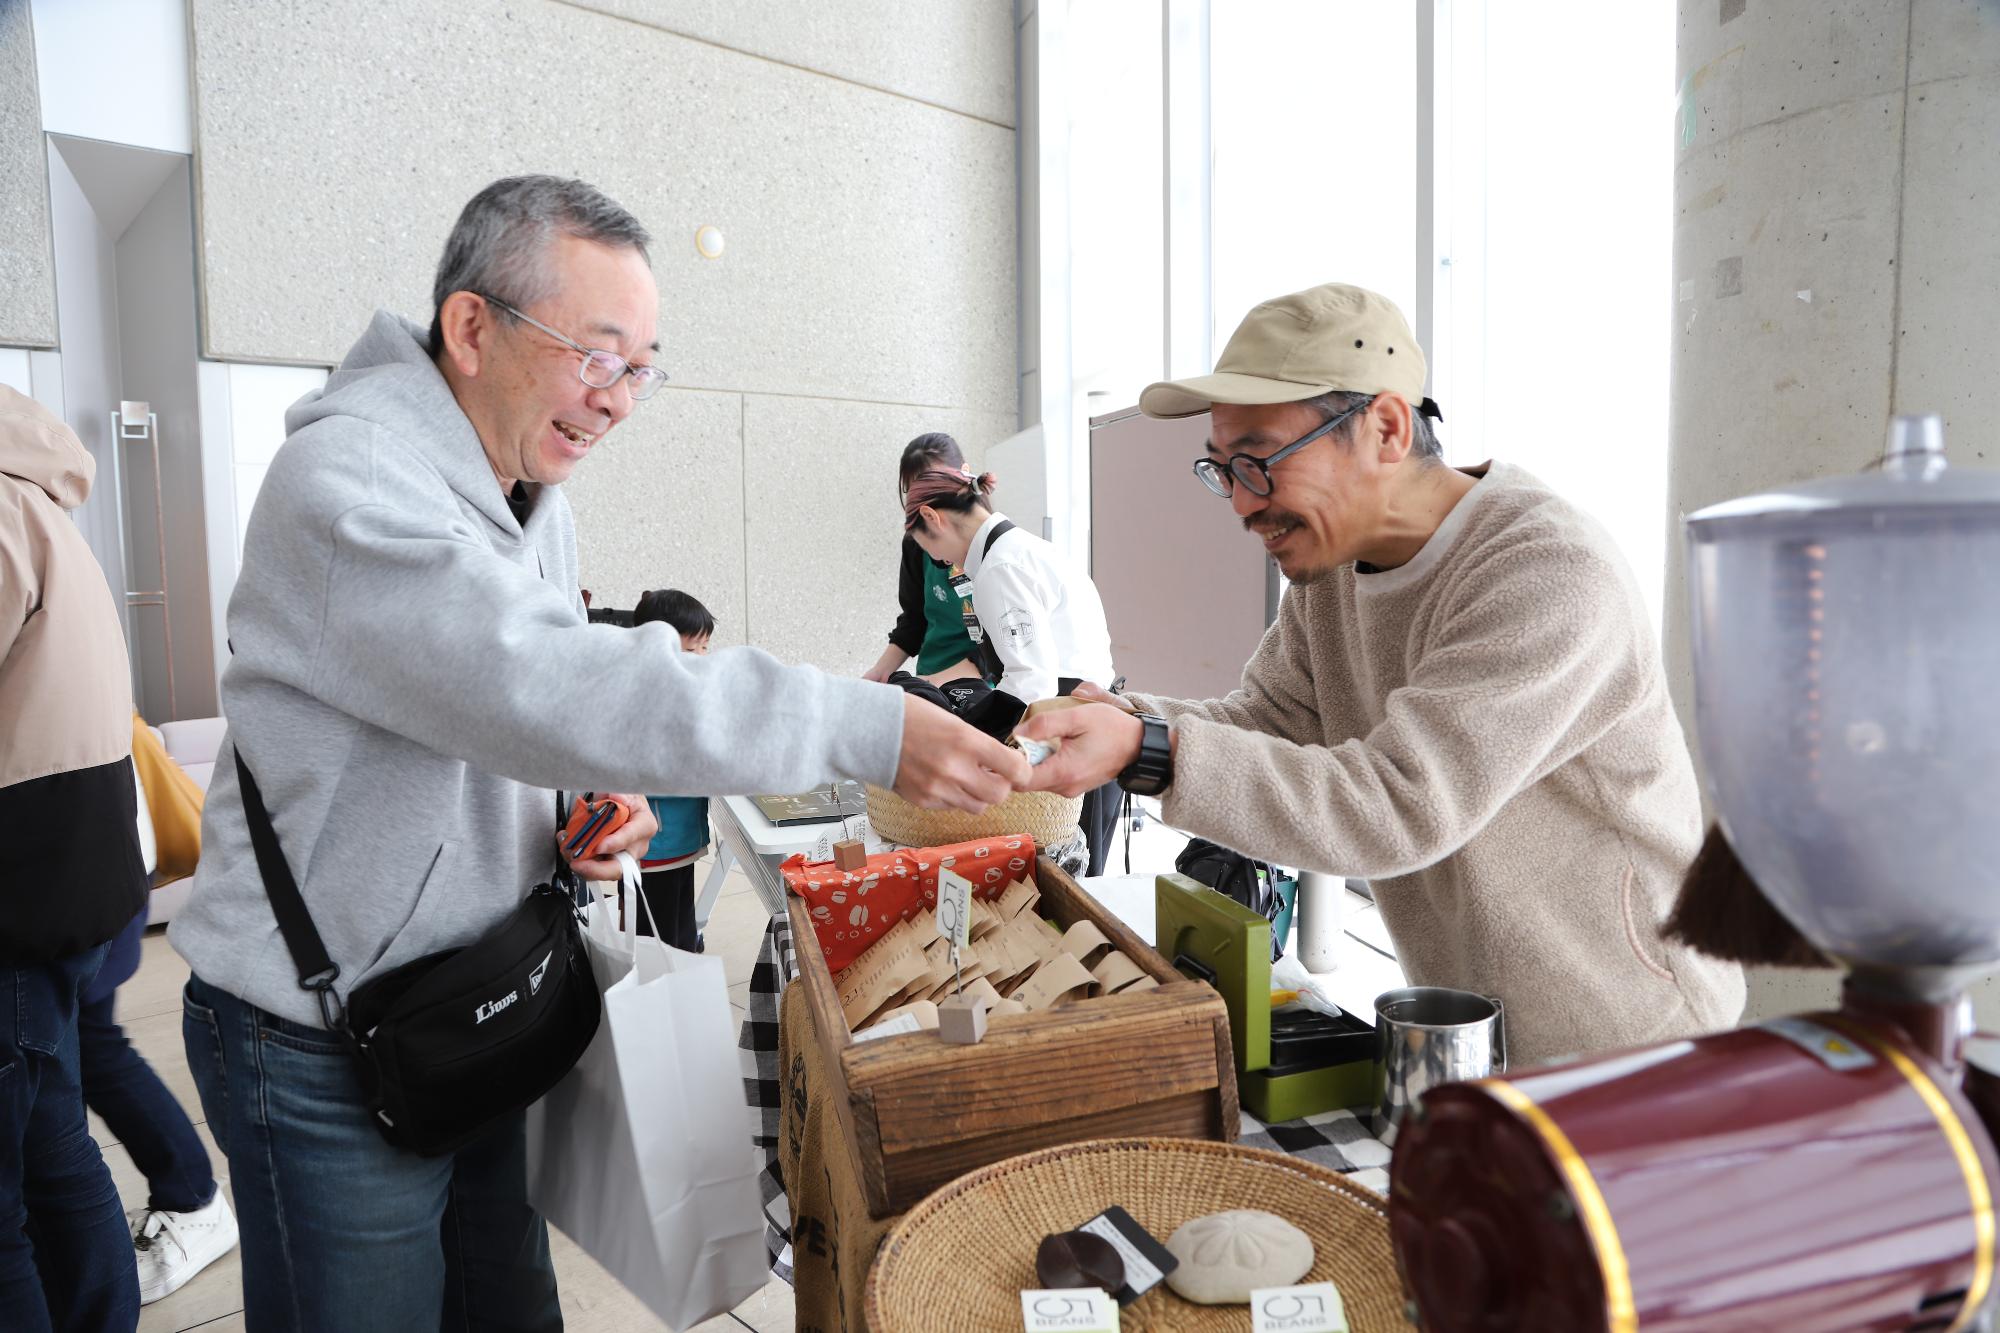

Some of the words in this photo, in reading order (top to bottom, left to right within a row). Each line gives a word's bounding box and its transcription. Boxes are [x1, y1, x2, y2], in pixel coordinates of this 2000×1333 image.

[956, 888, 966, 938] BEANS
[475, 990, 518, 1024] Lions
[1035, 1316, 1096, 1327] BEANS
[1264, 1317, 1327, 1330] BEANS
